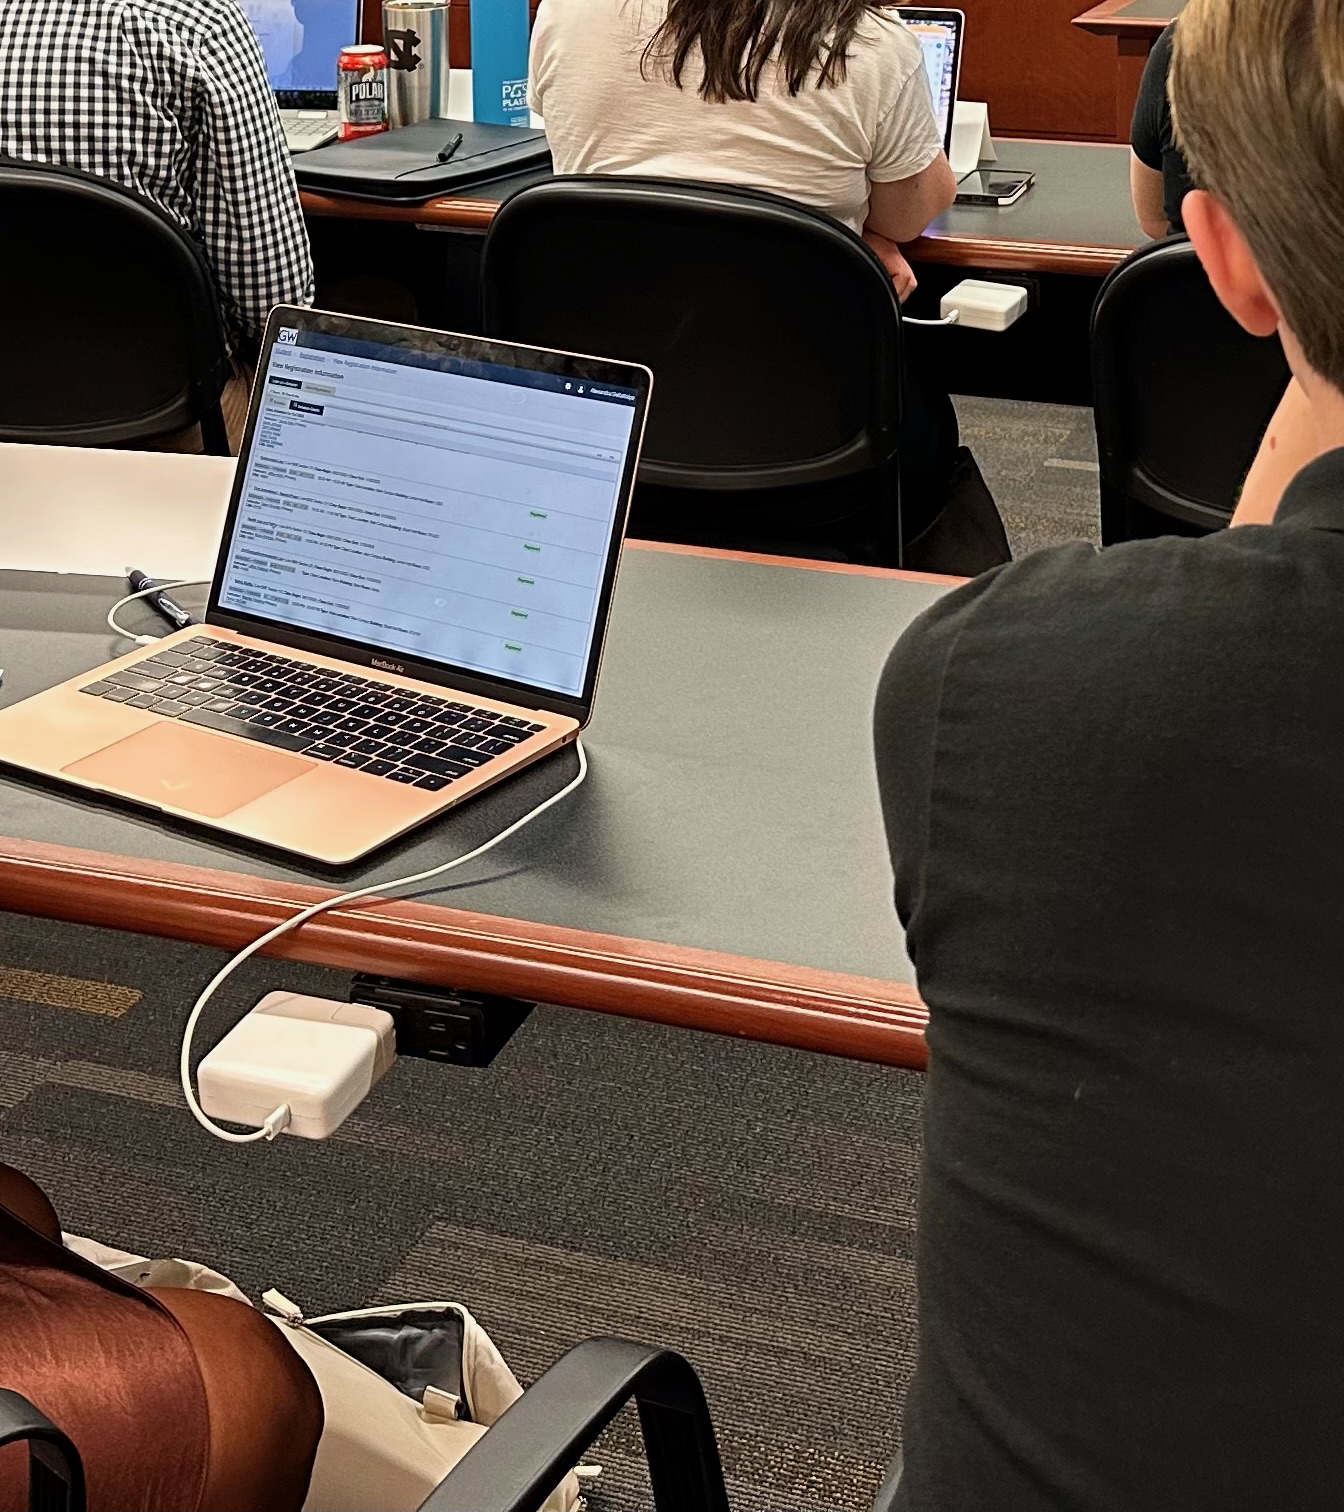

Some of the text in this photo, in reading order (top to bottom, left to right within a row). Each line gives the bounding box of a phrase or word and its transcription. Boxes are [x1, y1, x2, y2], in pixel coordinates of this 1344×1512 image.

[351, 82, 384, 102] POLAR
[279, 329, 298, 342] GW
[284, 362, 314, 375] Registration
[314, 369, 345, 380] Information
[371, 657, 405, 673] MacBook Air
